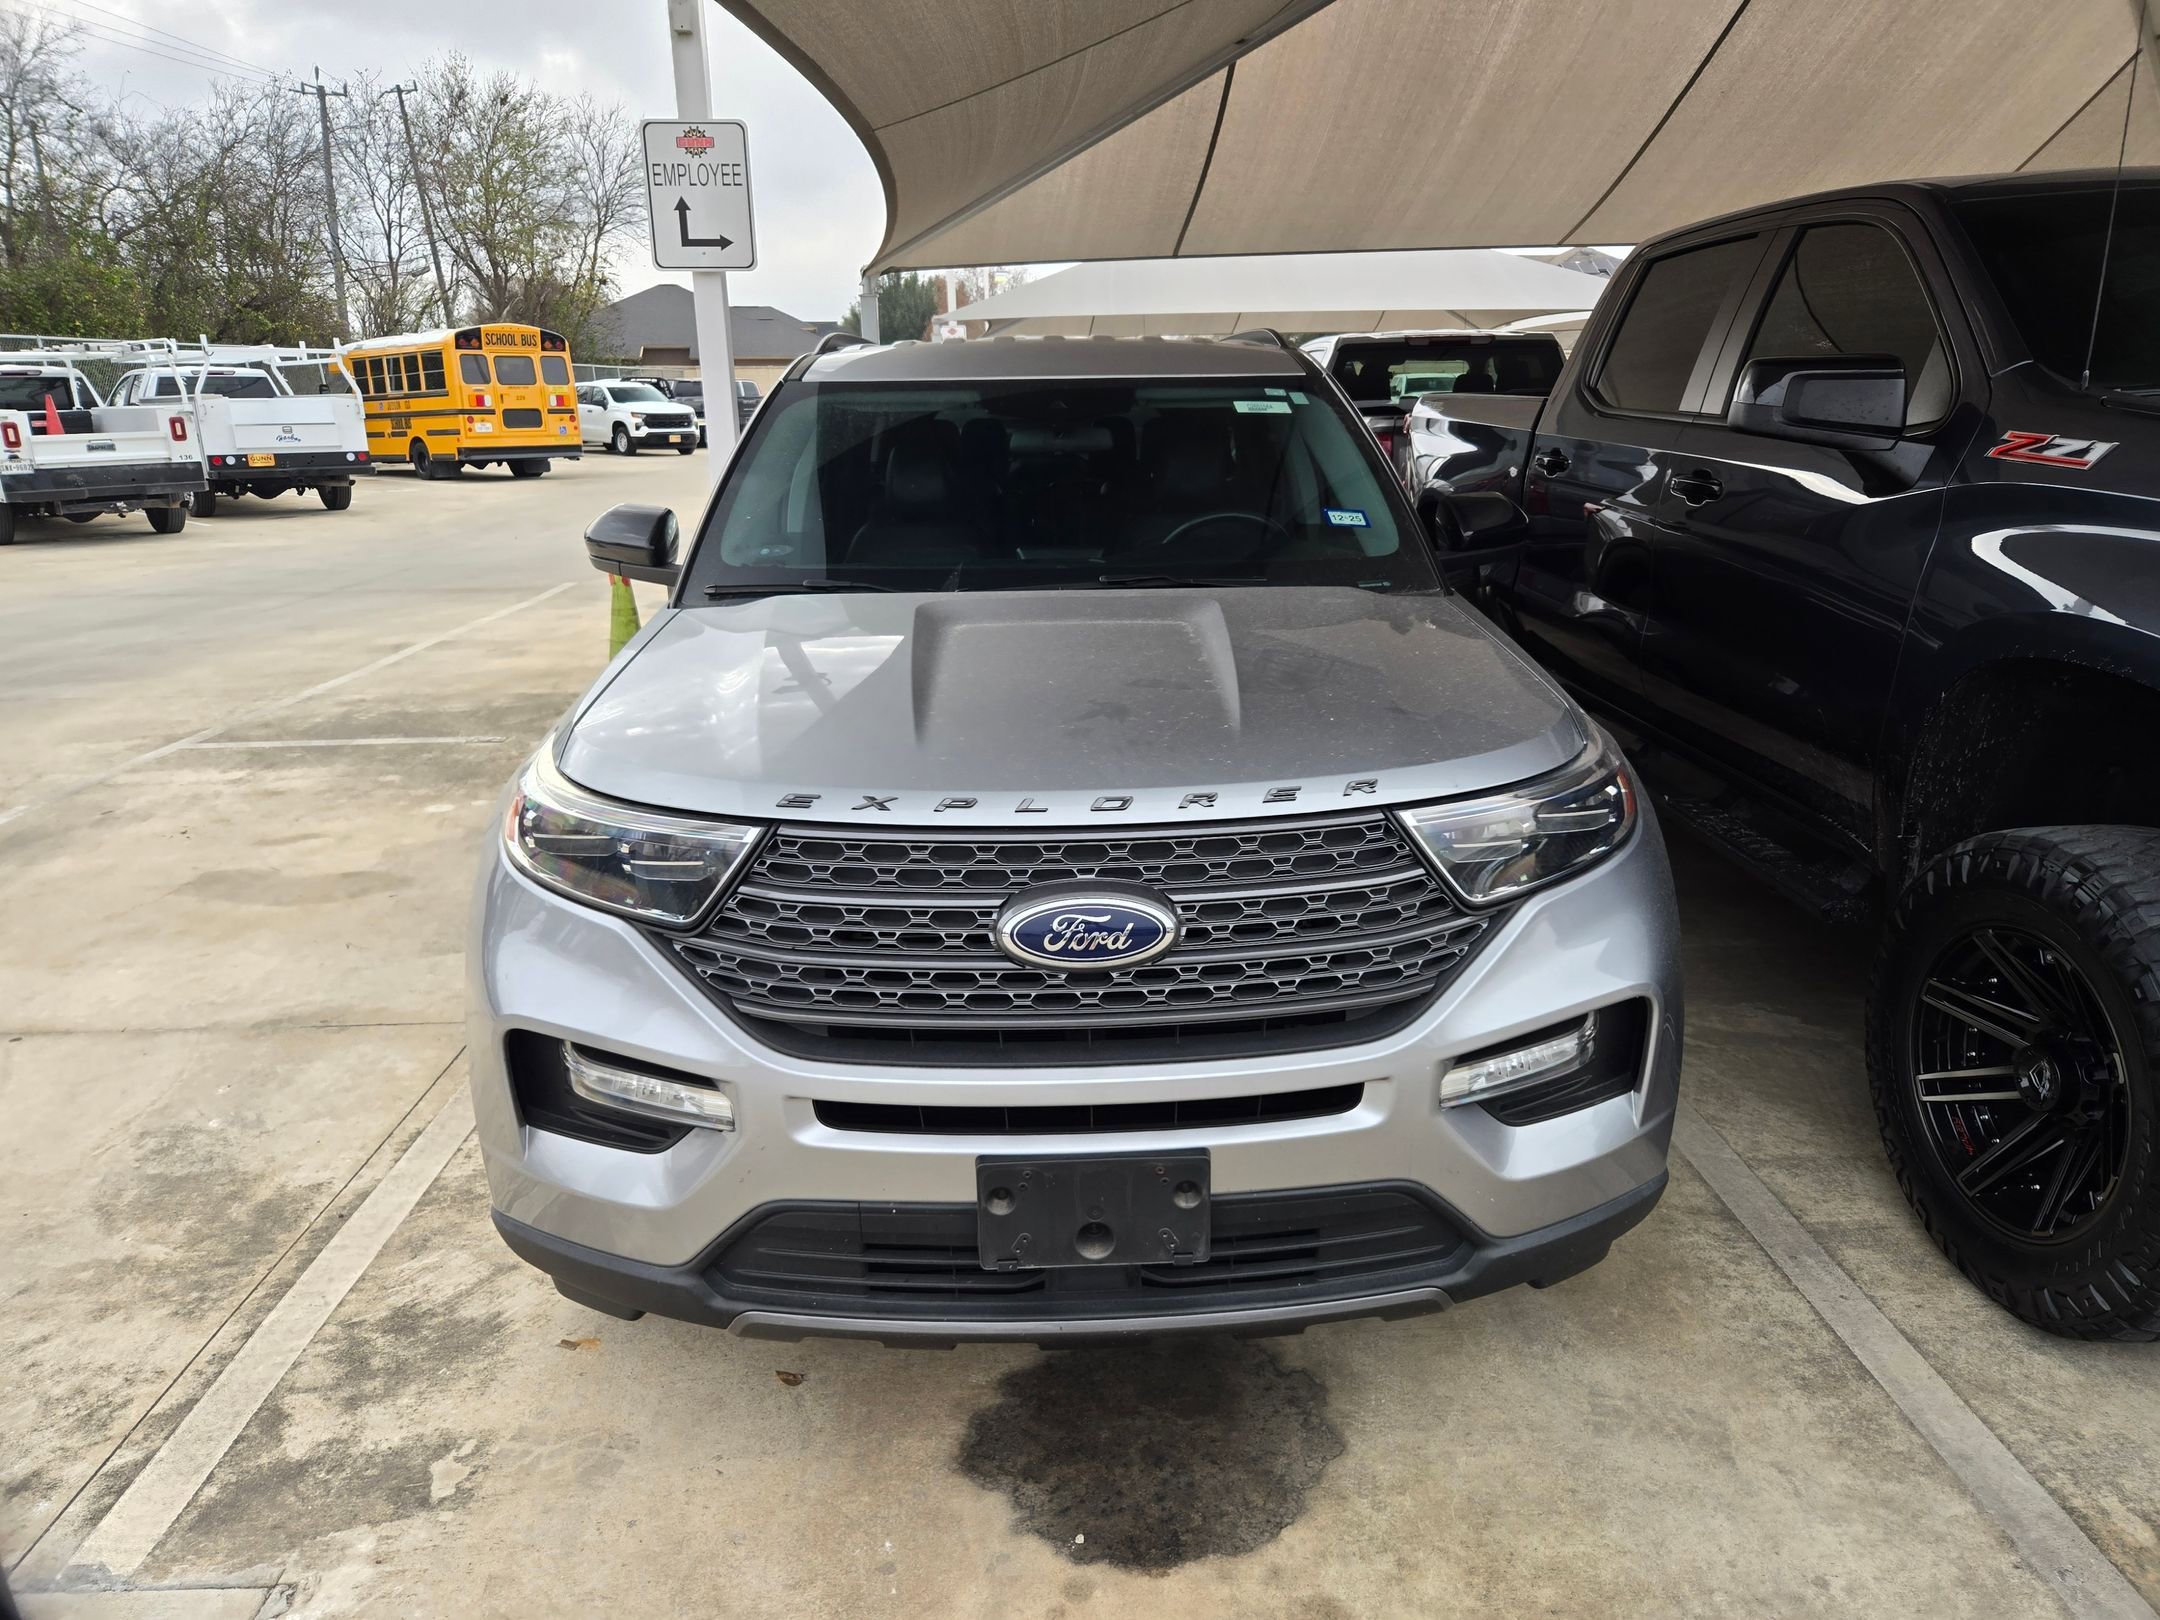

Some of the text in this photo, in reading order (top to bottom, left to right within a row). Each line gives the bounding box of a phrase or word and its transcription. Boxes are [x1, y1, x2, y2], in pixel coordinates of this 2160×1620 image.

[652, 163, 743, 187] EMPLOYEE
[485, 332, 537, 347] SCHOOL BUS
[1984, 430, 2120, 470] Z71
[776, 778, 1379, 813] EXPLORER
[1043, 914, 1135, 952] Ford
